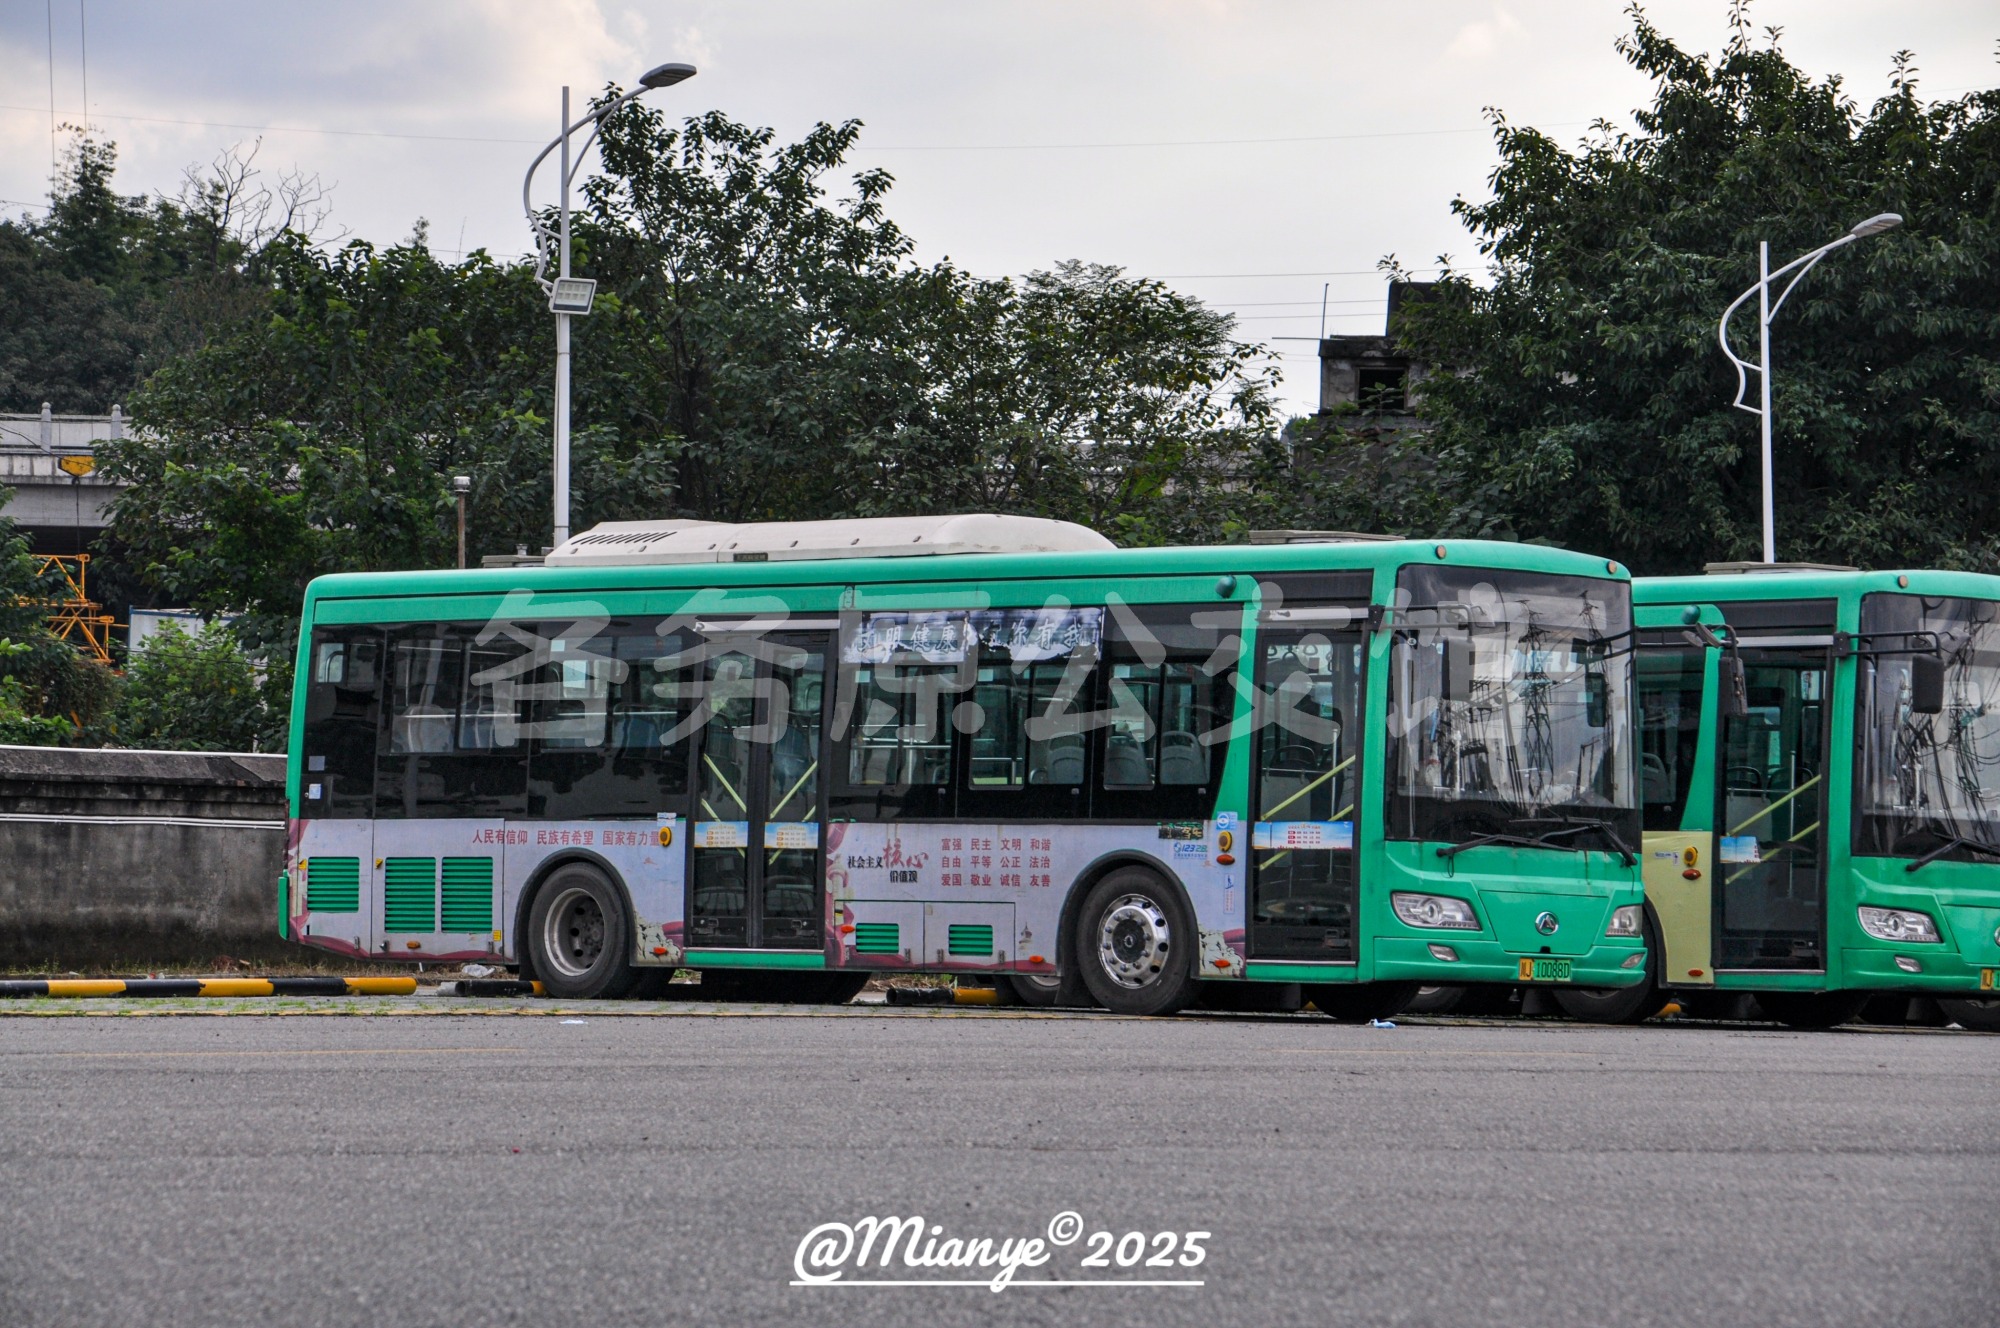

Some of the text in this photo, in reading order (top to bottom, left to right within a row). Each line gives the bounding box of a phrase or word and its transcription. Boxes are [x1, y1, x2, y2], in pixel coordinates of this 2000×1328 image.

[472, 829, 661, 846] 人民有信仰 民族有希望 国家有力量
[941, 838, 1051, 851] 富强 民主 文明 和谐
[941, 856, 1051, 869] 自由 平等 公正 法治
[889, 870, 918, 883] 价值观
[941, 874, 1051, 887] 爱国 敬业 诚信 友善
